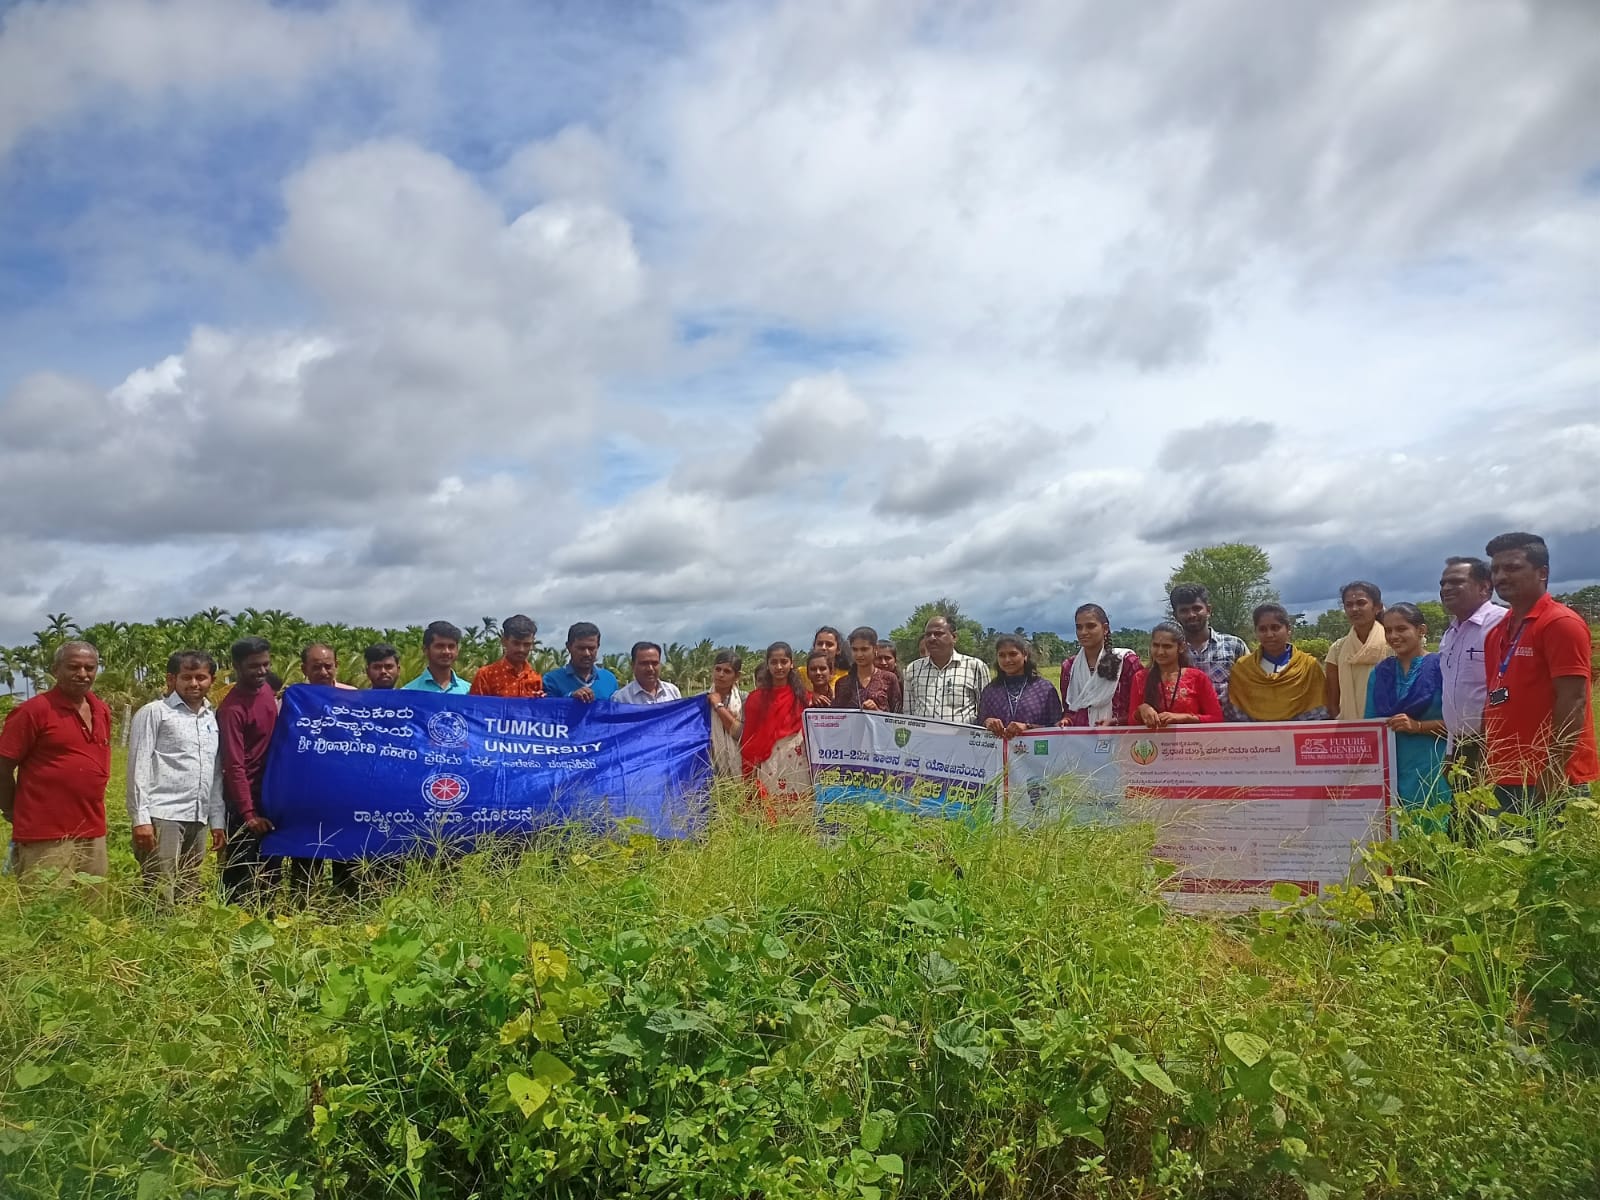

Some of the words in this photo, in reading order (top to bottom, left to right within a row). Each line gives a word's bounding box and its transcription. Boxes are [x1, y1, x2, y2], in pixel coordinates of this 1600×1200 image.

[331, 705, 414, 719] ತುಮಕೂರು
[484, 717, 569, 739] TUMKUR
[297, 736, 312, 753] ಶ್ರೀ
[484, 740, 602, 756] UNIVERSITY
[1329, 737, 1366, 746] FUTURE
[1330, 745, 1372, 754] GENERALI
[353, 809, 415, 832] ರಾಷ್ಟ್ರೀಯ
[423, 808, 464, 824] ಸೇವಾ
[471, 806, 534, 823] ಯೋಜನೆ
